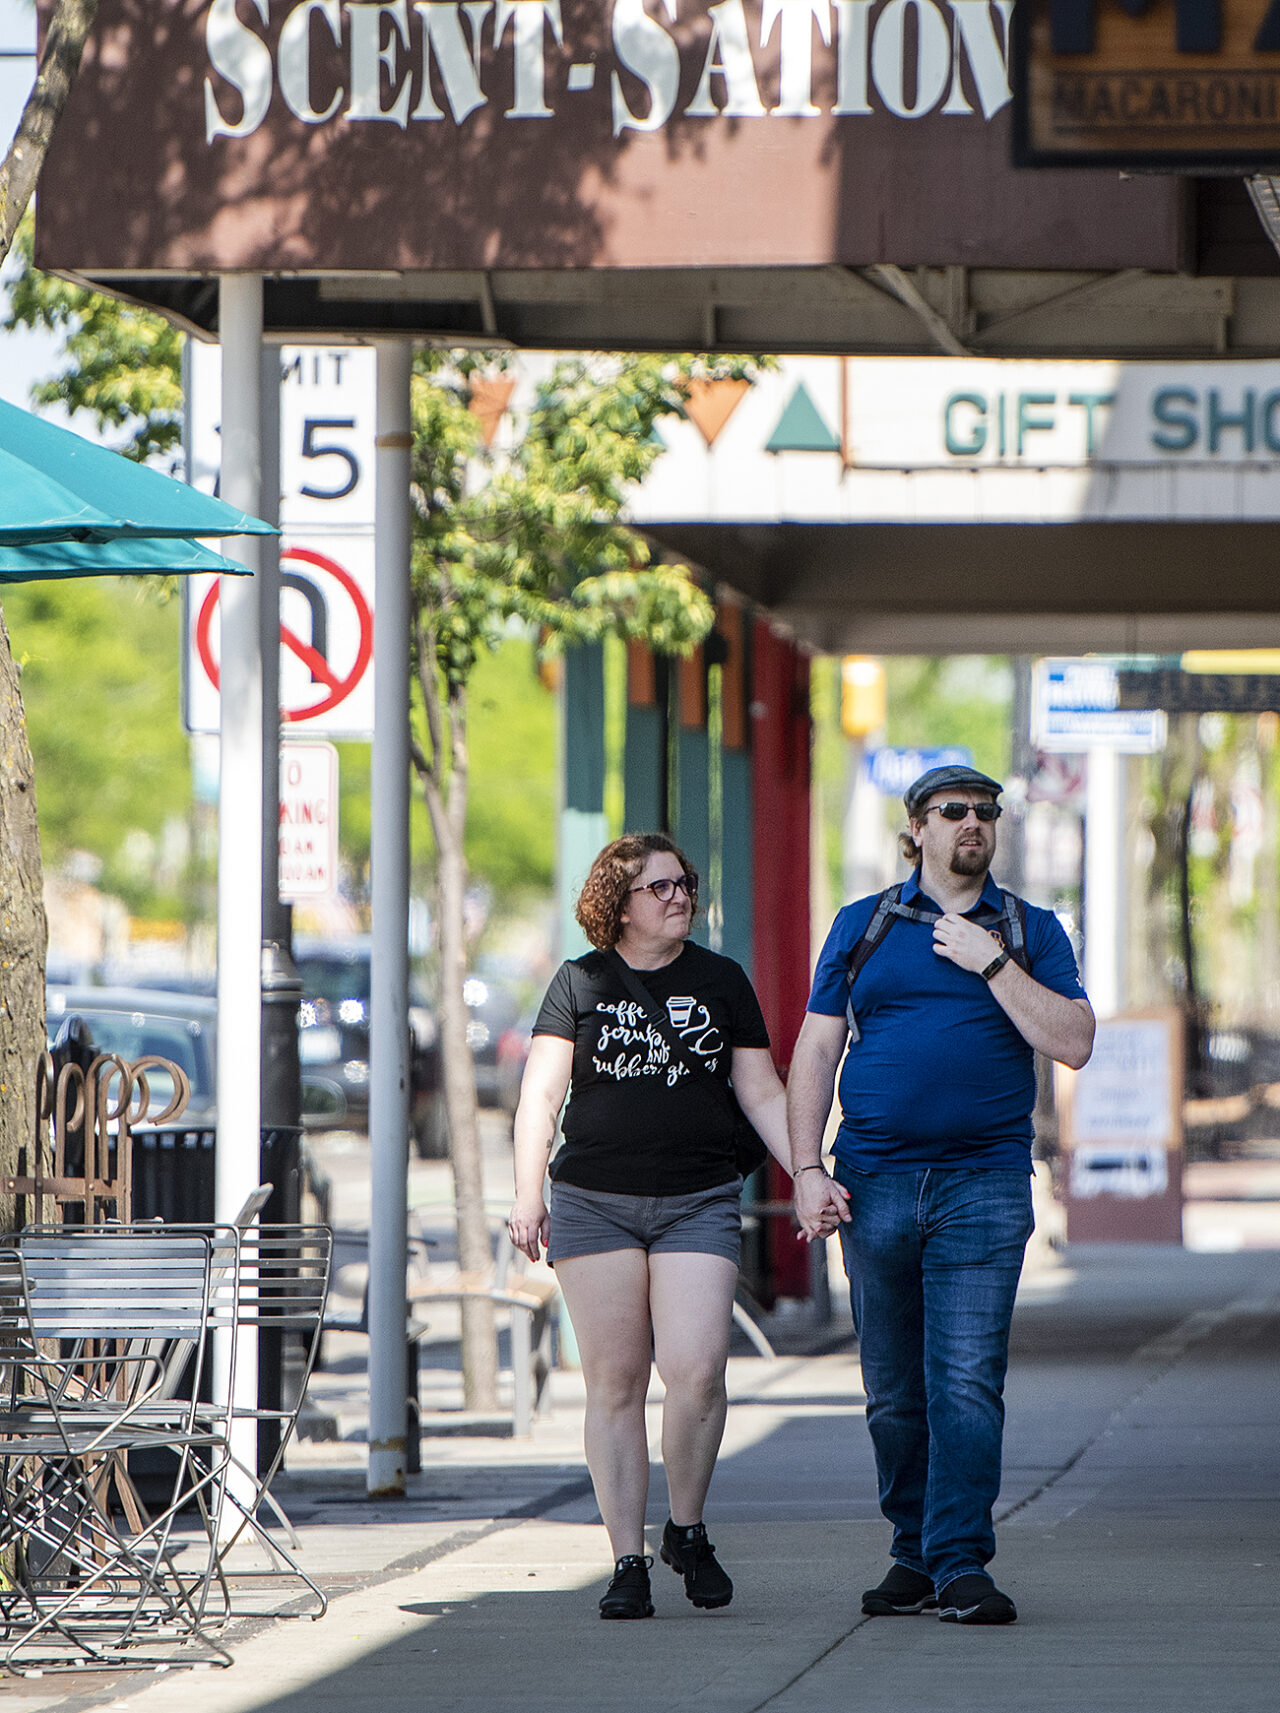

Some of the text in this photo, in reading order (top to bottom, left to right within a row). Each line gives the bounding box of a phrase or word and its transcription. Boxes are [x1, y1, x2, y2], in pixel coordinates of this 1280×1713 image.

[1053, 76, 1279, 123] MACARONI
[945, 391, 1114, 456] GIFT
[596, 1000, 648, 1027] coffe
[646, 1048, 670, 1064] AND
